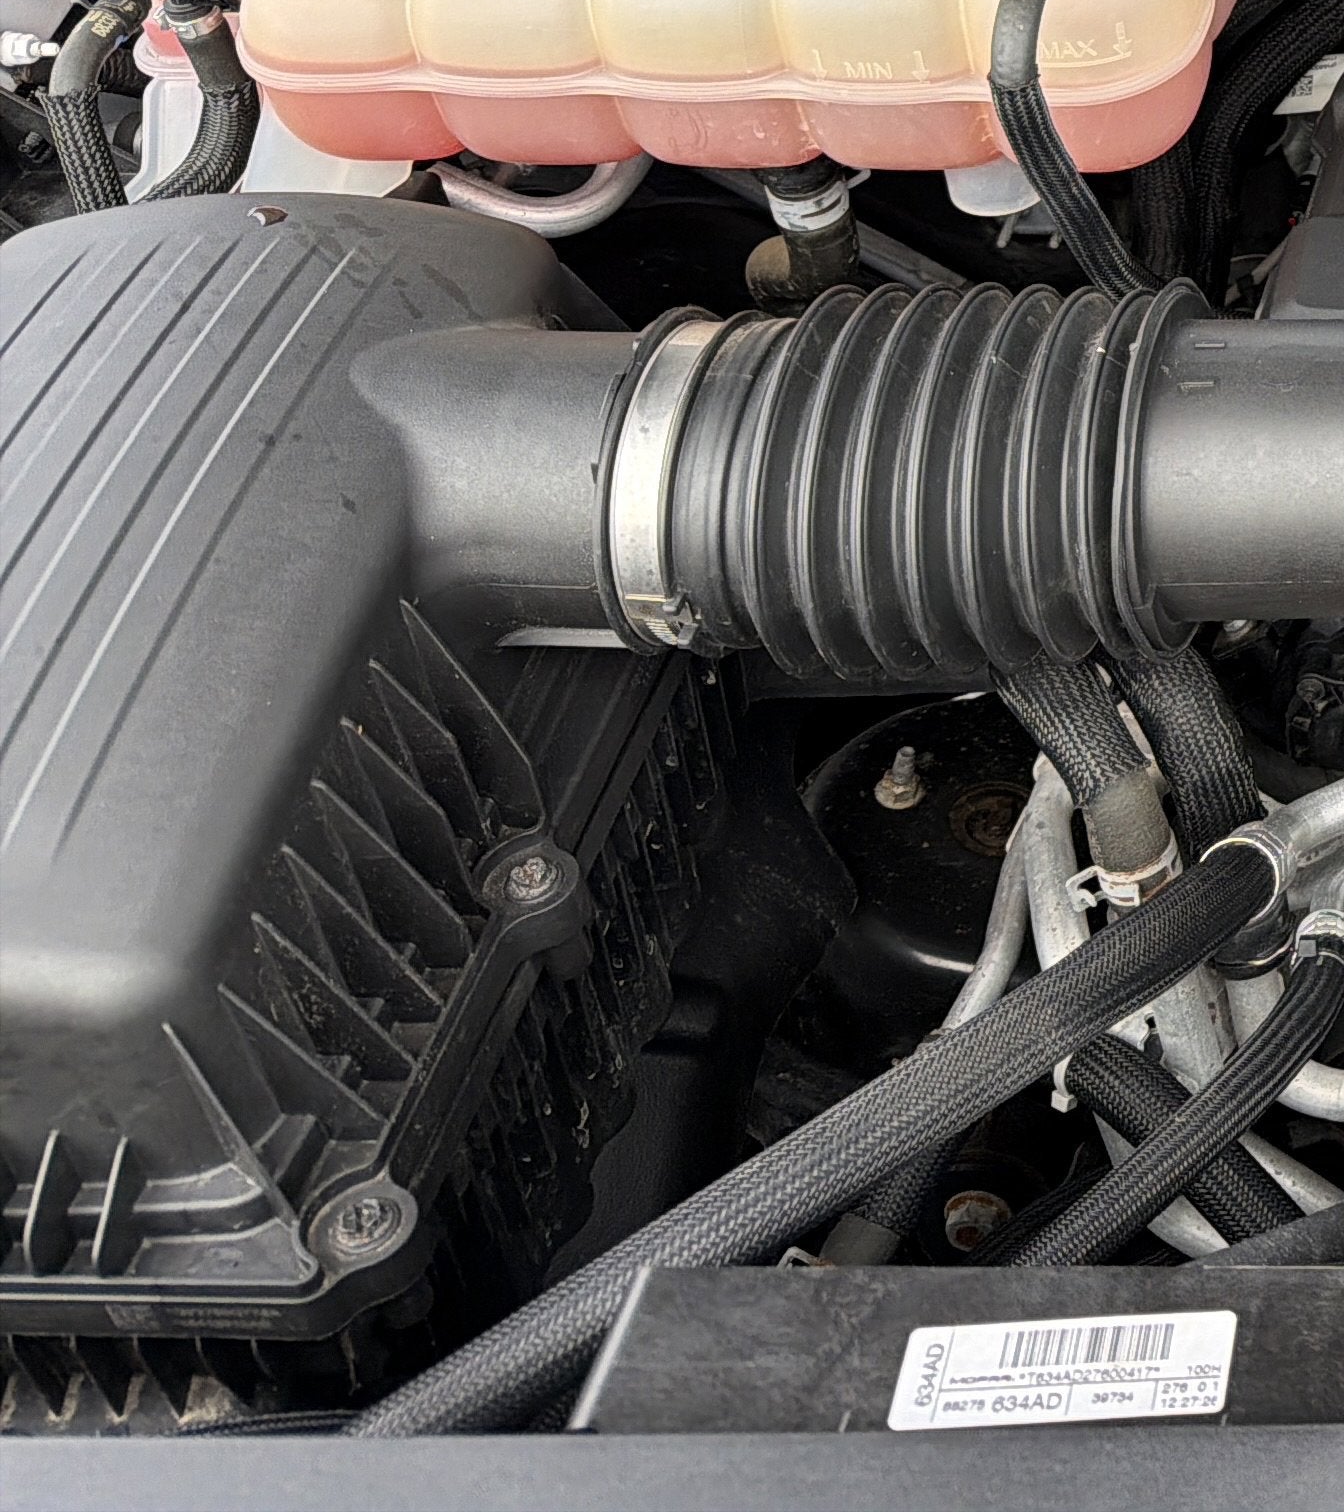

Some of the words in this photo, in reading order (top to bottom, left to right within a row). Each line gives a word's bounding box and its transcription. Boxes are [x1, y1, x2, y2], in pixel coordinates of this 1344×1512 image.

[844, 61, 894, 80] MIN
[1040, 39, 1098, 60] MAX
[914, 1343, 945, 1407] 634AD
[991, 1391, 1063, 1413] 634AD
